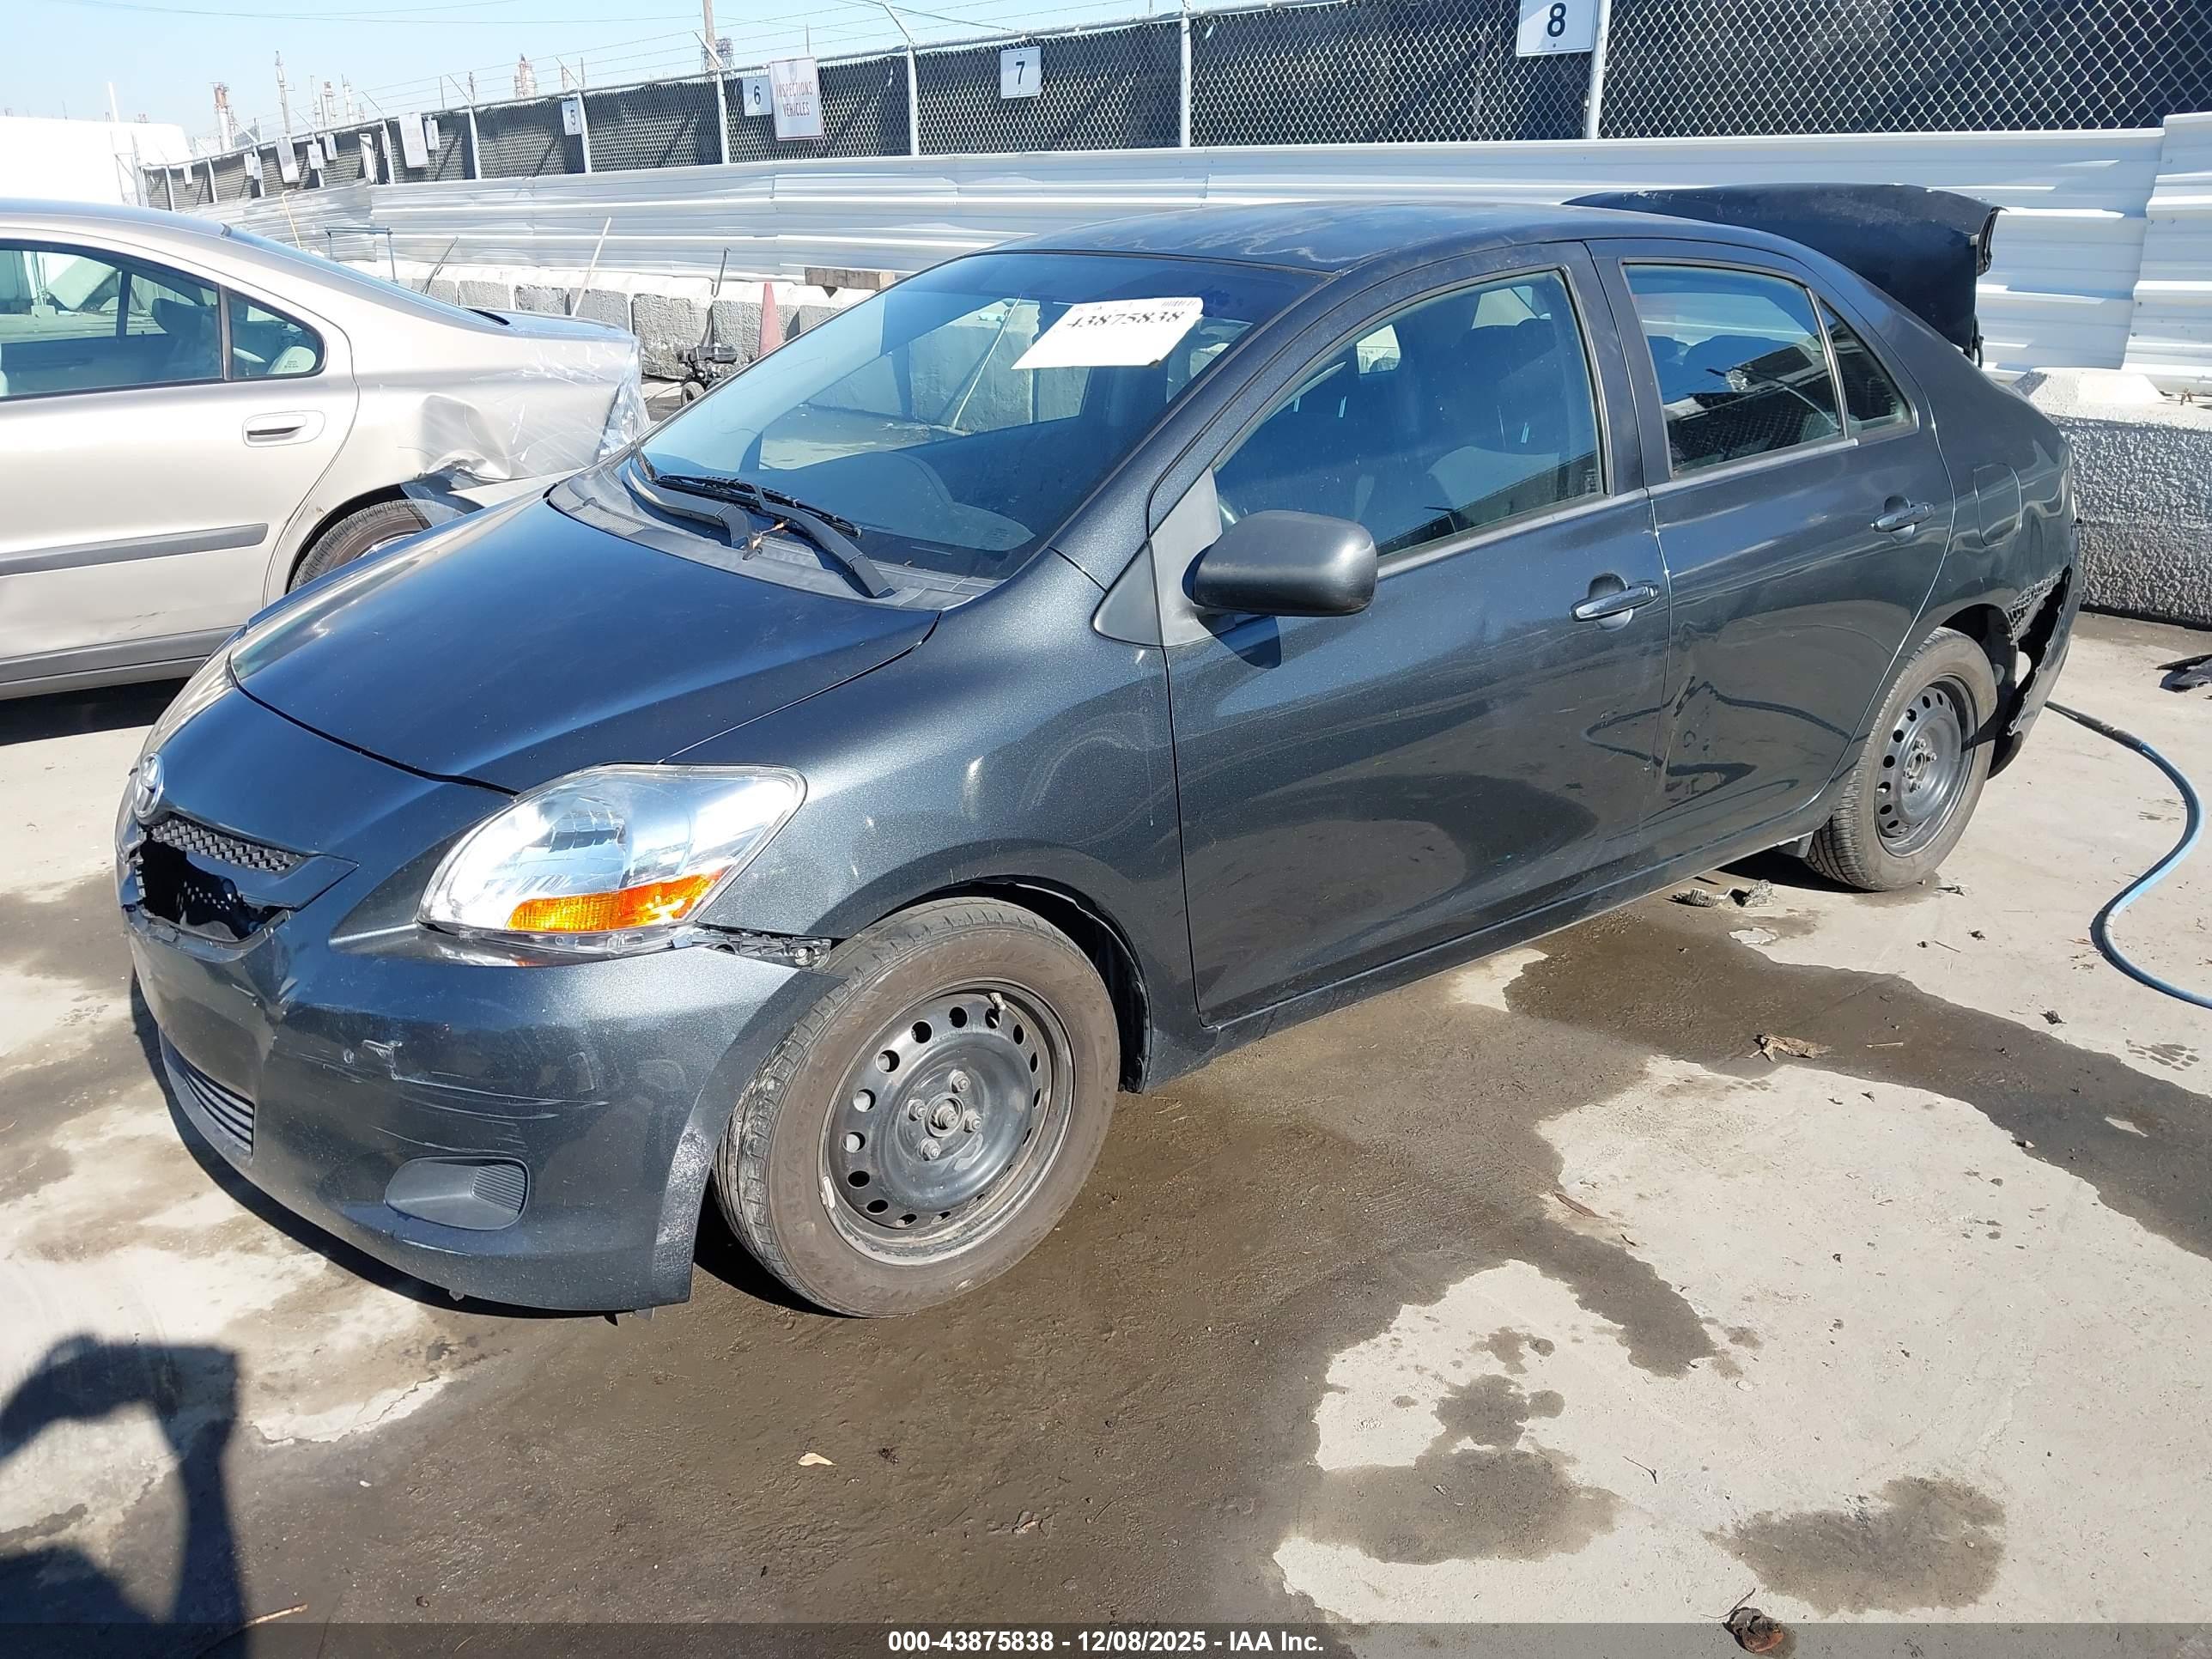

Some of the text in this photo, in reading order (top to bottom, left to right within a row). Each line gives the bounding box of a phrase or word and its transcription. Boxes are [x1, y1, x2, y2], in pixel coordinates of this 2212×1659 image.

[1547, 2, 1567, 38] 8
[1015, 60, 1026, 85] 7
[753, 84, 762, 106] 6
[775, 81, 813, 98] INSPECTIONS
[569, 109, 576, 126] 5
[782, 101, 811, 118] VEHICLES
[1066, 311, 1186, 328] 43875838
